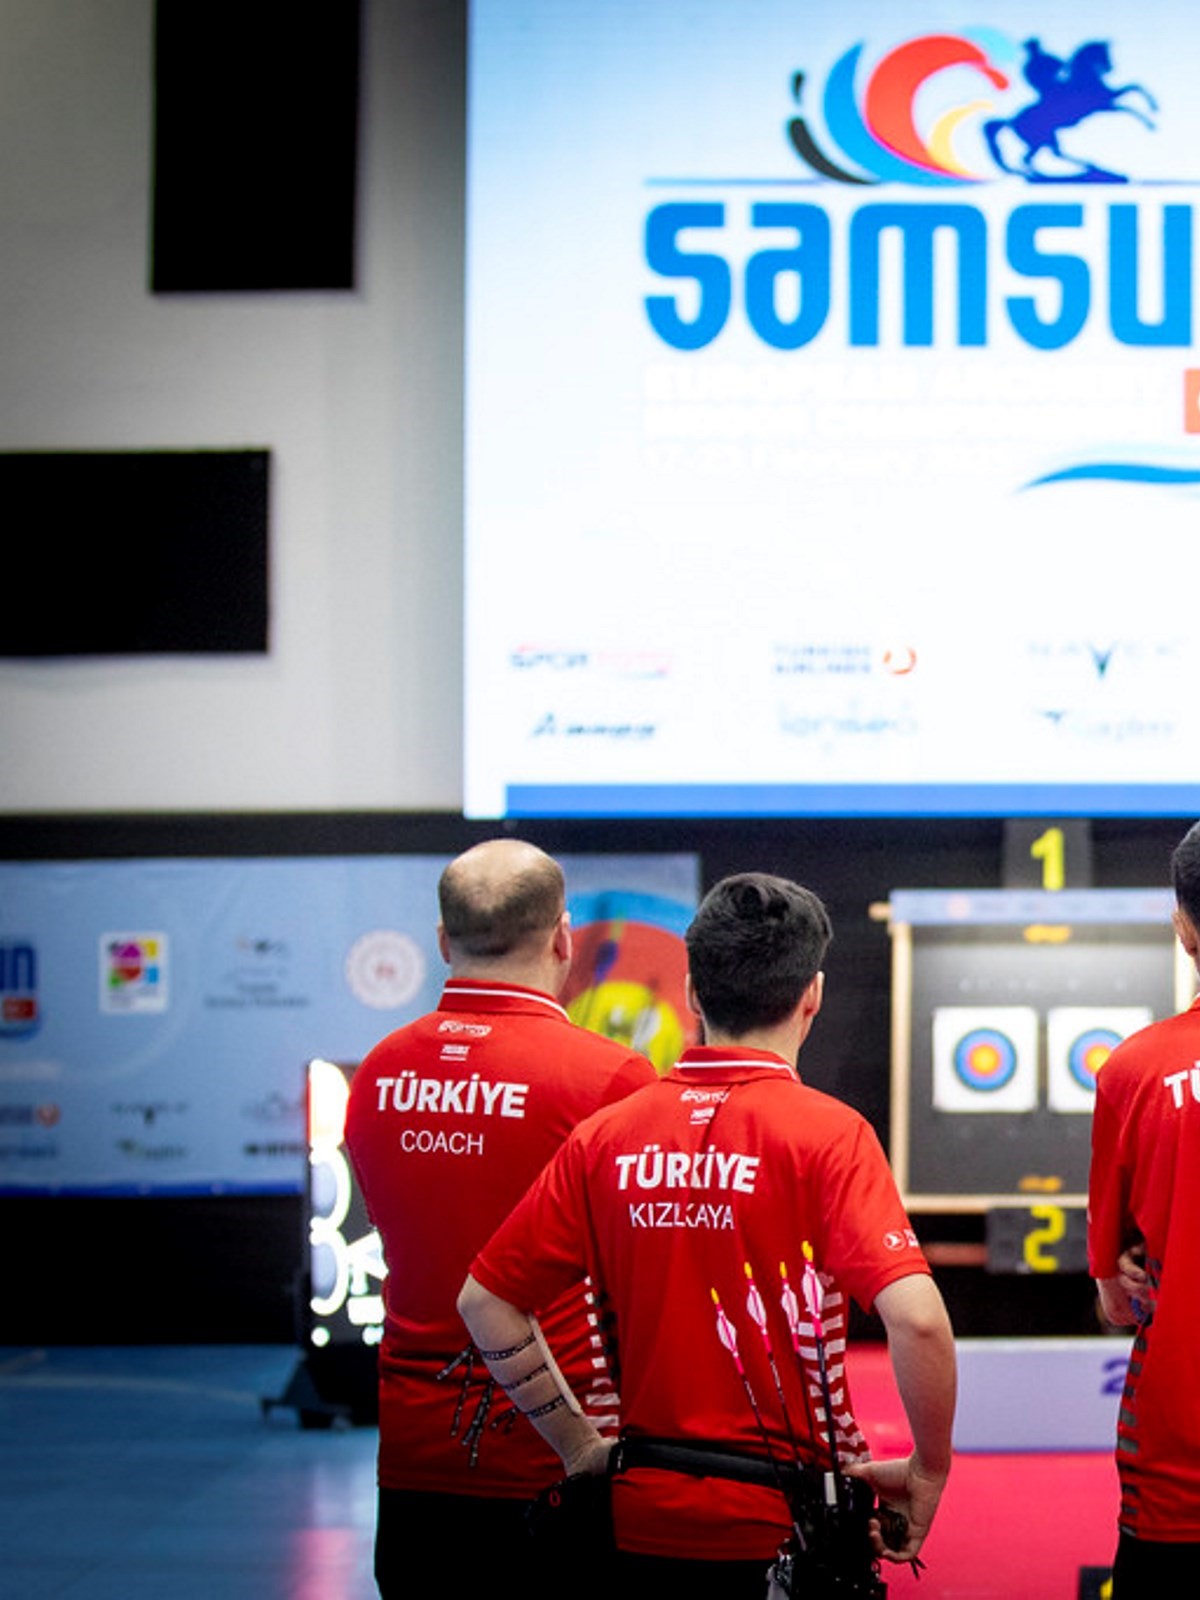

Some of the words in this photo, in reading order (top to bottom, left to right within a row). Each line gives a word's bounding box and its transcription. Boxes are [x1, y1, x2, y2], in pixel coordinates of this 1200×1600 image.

[1031, 828, 1065, 891] 1
[375, 1070, 529, 1119] TÜRKİYE
[400, 1130, 484, 1155] COACH
[615, 1144, 760, 1195] TÜRKİYE
[1023, 1205, 1066, 1271] 2
